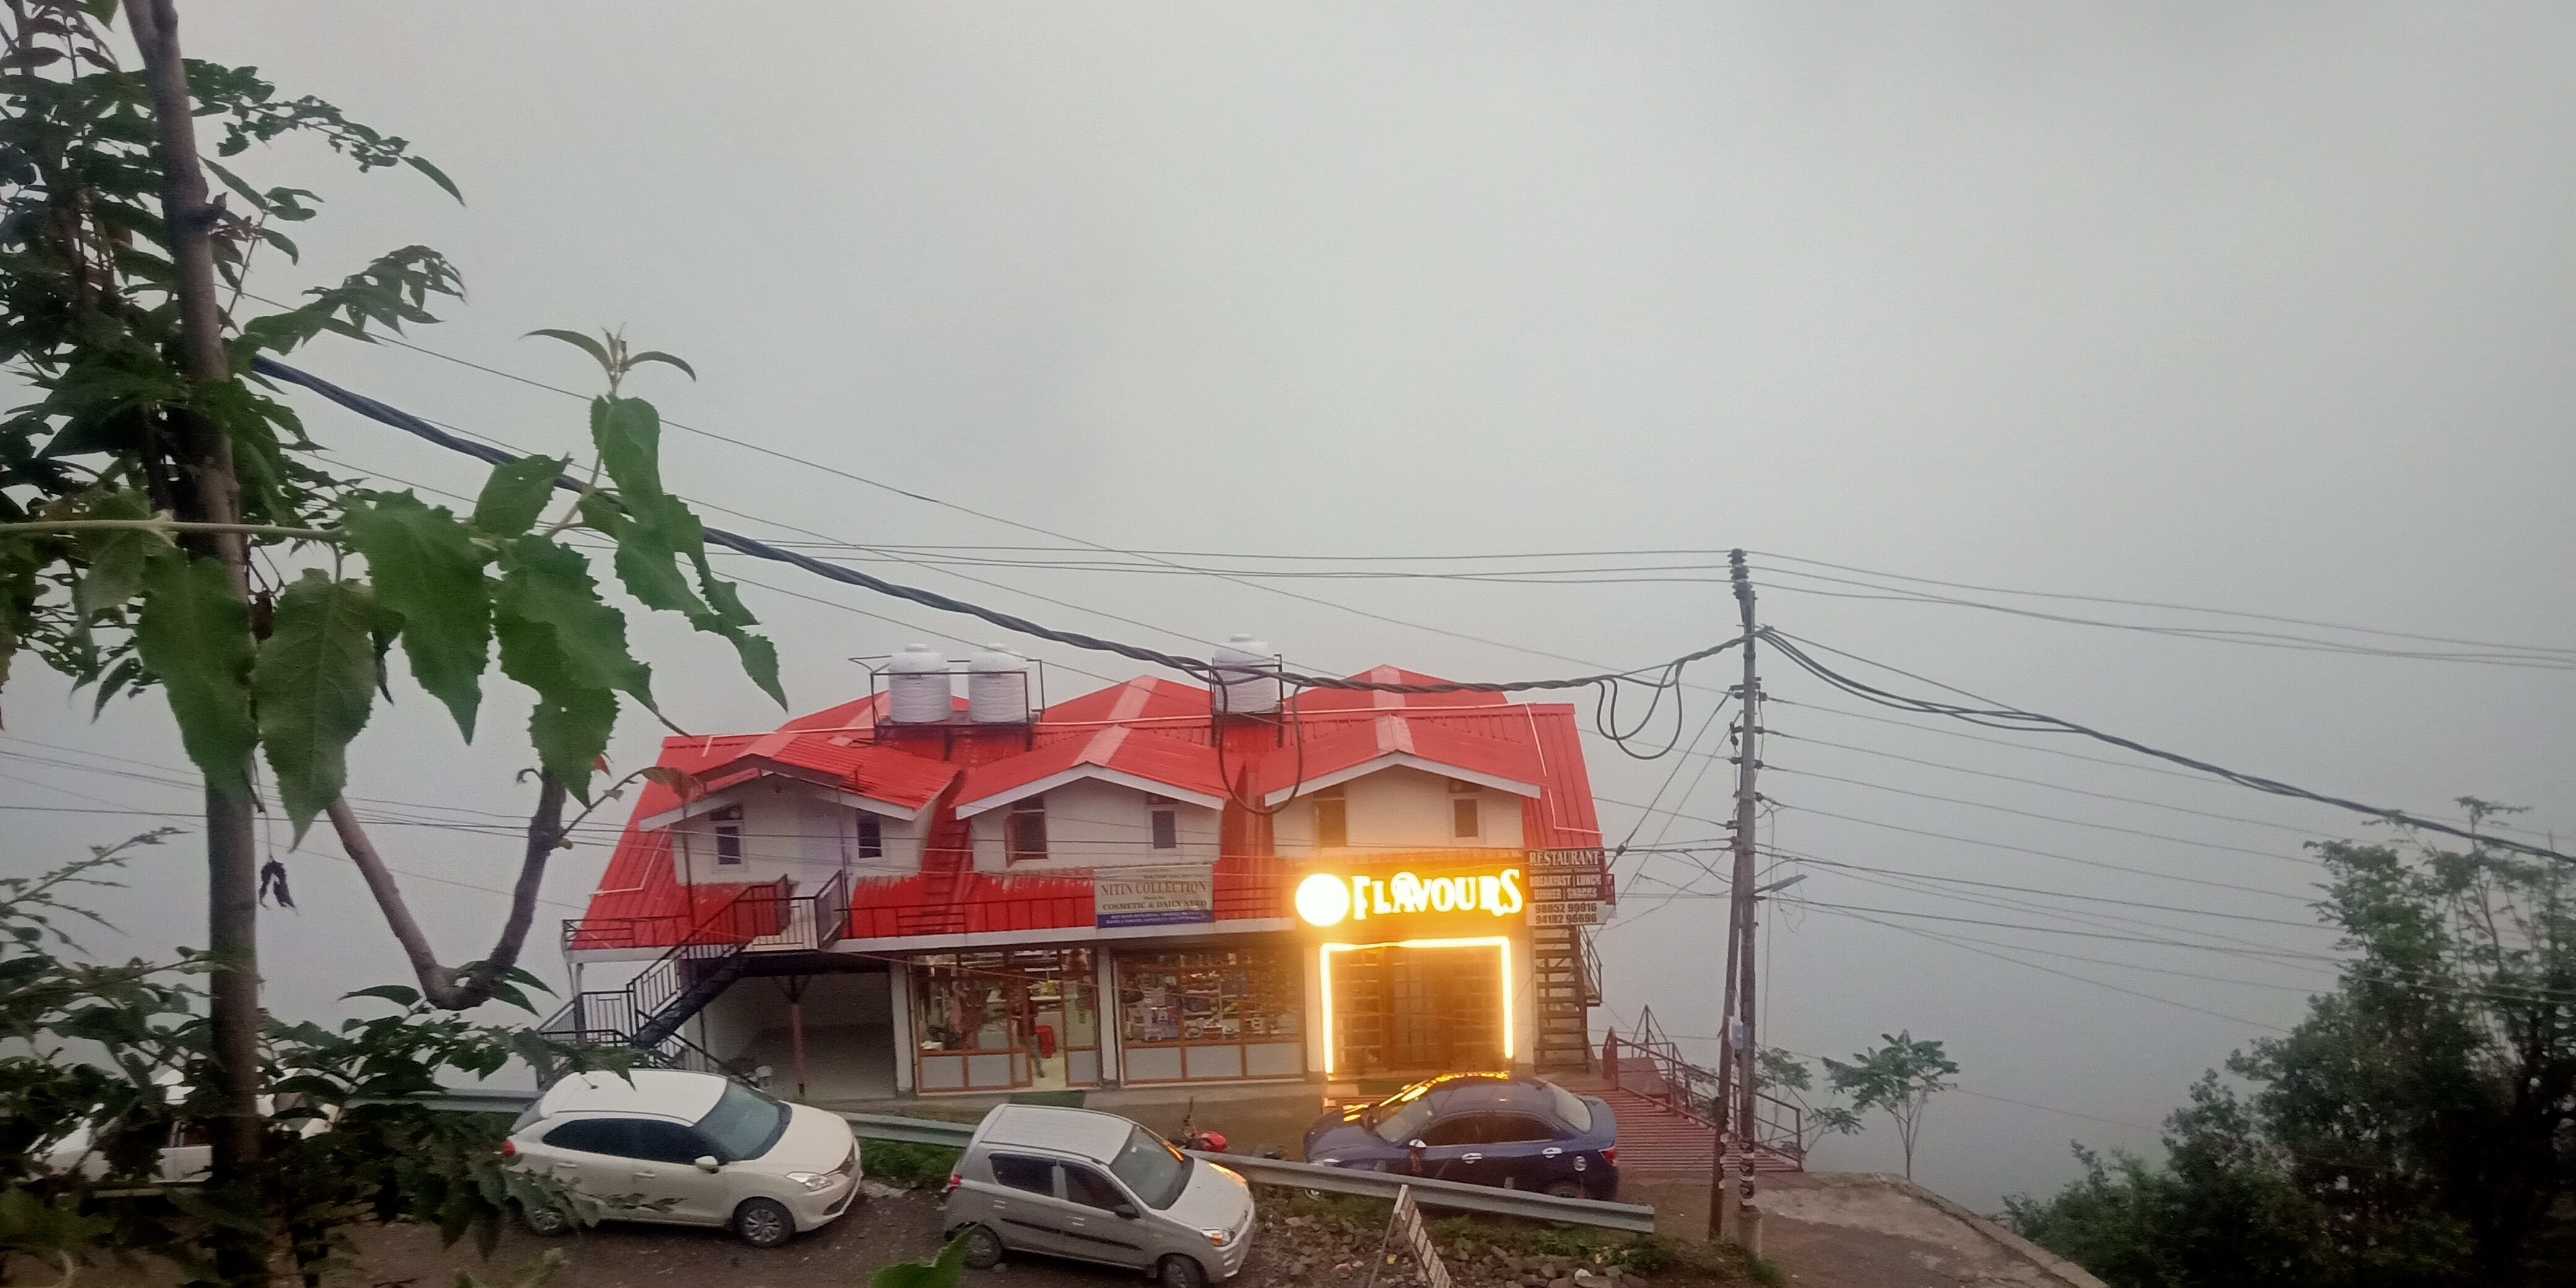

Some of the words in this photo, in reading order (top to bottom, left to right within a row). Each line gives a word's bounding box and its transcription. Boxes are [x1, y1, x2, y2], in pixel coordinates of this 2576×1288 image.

[1529, 851, 1599, 866] RESTAURANT
[1529, 875, 1572, 887] BREAKFAST
[1576, 874, 1601, 886] LUNCH
[1101, 883, 1133, 896] NITIN
[1136, 881, 1206, 894] COLLECTION
[1351, 868, 1523, 920] FLAVOURS
[1103, 902, 1146, 910] COSMETIC
[1535, 903, 1565, 913] 98052
[1536, 913, 1564, 924] 94182
